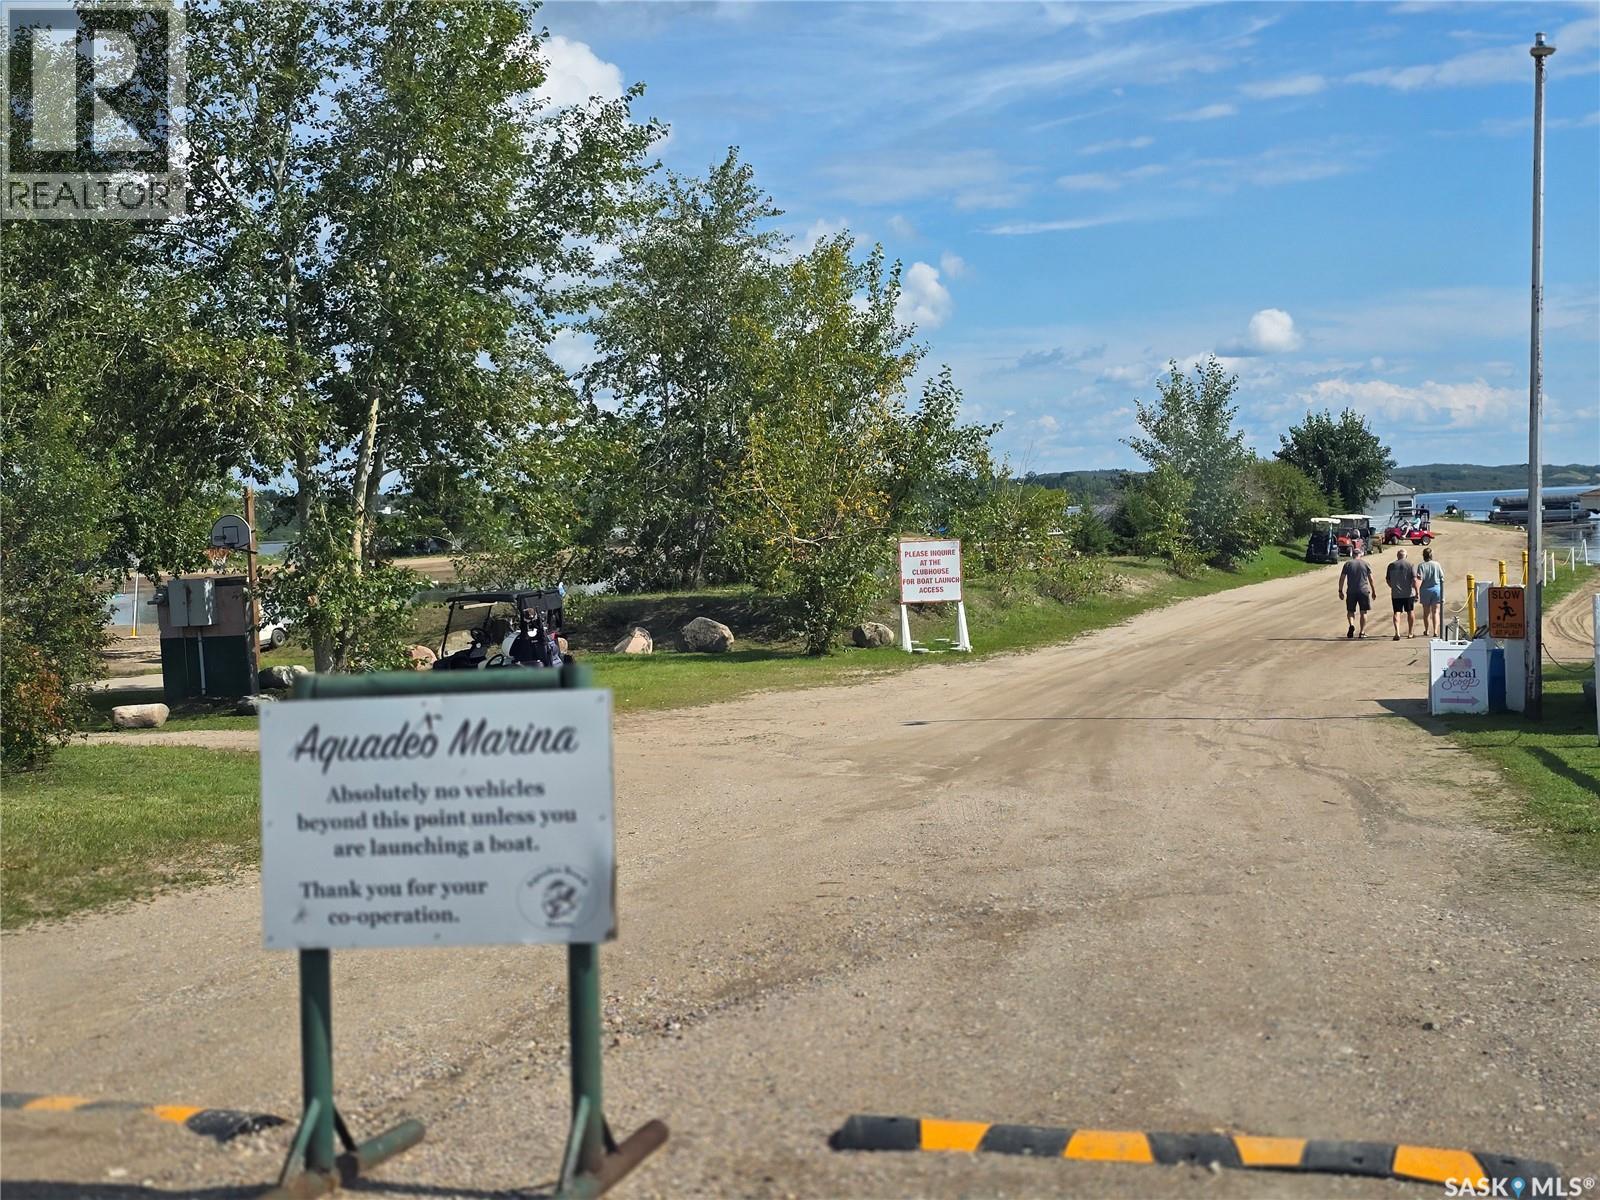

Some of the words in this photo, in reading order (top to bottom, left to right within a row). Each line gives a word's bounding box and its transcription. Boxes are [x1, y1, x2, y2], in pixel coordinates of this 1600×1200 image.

[904, 550, 929, 558] PLEASE
[1492, 591, 1520, 599] SLOW
[1441, 678, 1480, 690] Scoop
[1442, 668, 1476, 678] Local
[448, 717, 579, 759] Marina
[326, 784, 431, 805] Absolutely
[435, 787, 460, 799] no
[464, 779, 546, 799] vehicles
[297, 811, 367, 834] beyond
[373, 810, 409, 829] this
[414, 809, 466, 831] point
[472, 807, 535, 827] unless
[540, 810, 577, 826] you
[334, 842, 366, 858] are
[370, 836, 470, 859] launching
[473, 840, 485, 854] a
[489, 835, 540, 853] boat.
[299, 880, 364, 900] Thank
[366, 884, 403, 902] you
[407, 878, 436, 896] for
[441, 881, 488, 898] your
[327, 906, 461, 927] co-operation.
